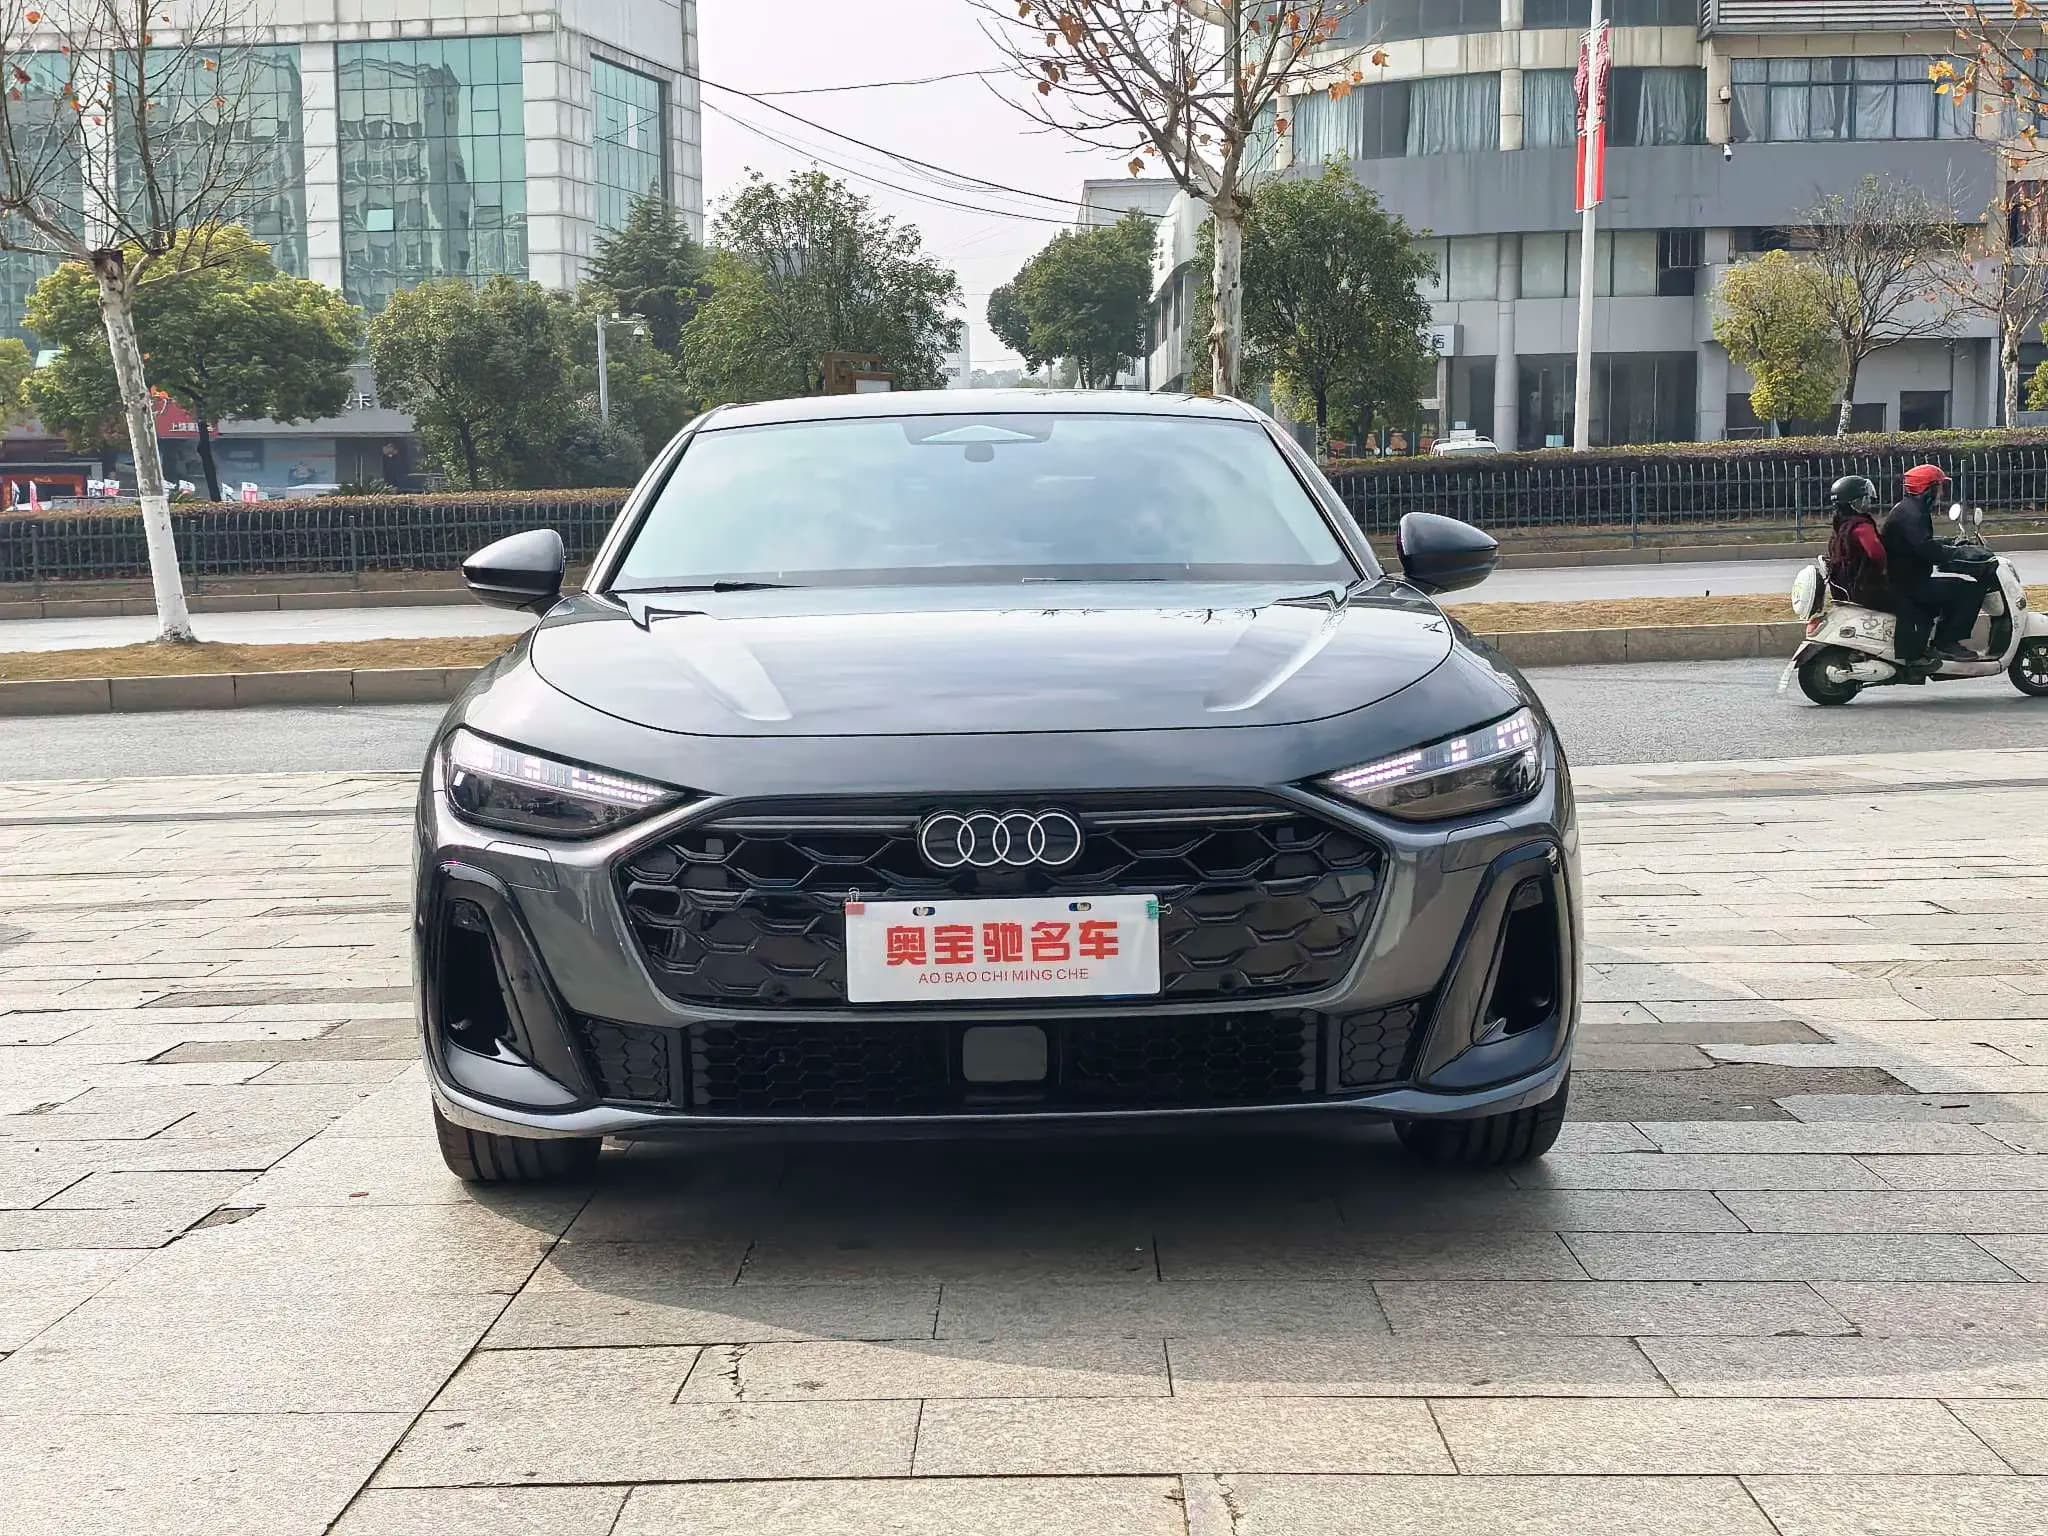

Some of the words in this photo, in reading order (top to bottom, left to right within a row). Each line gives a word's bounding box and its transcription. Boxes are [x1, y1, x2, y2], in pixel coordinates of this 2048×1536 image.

[887, 920, 1119, 966] 奥宝驰名车
[918, 972, 940, 984] AO
[944, 971, 977, 983] BAO
[981, 970, 1008, 981] CHI
[1012, 969, 1052, 980] MING
[1056, 968, 1089, 979] CHE
